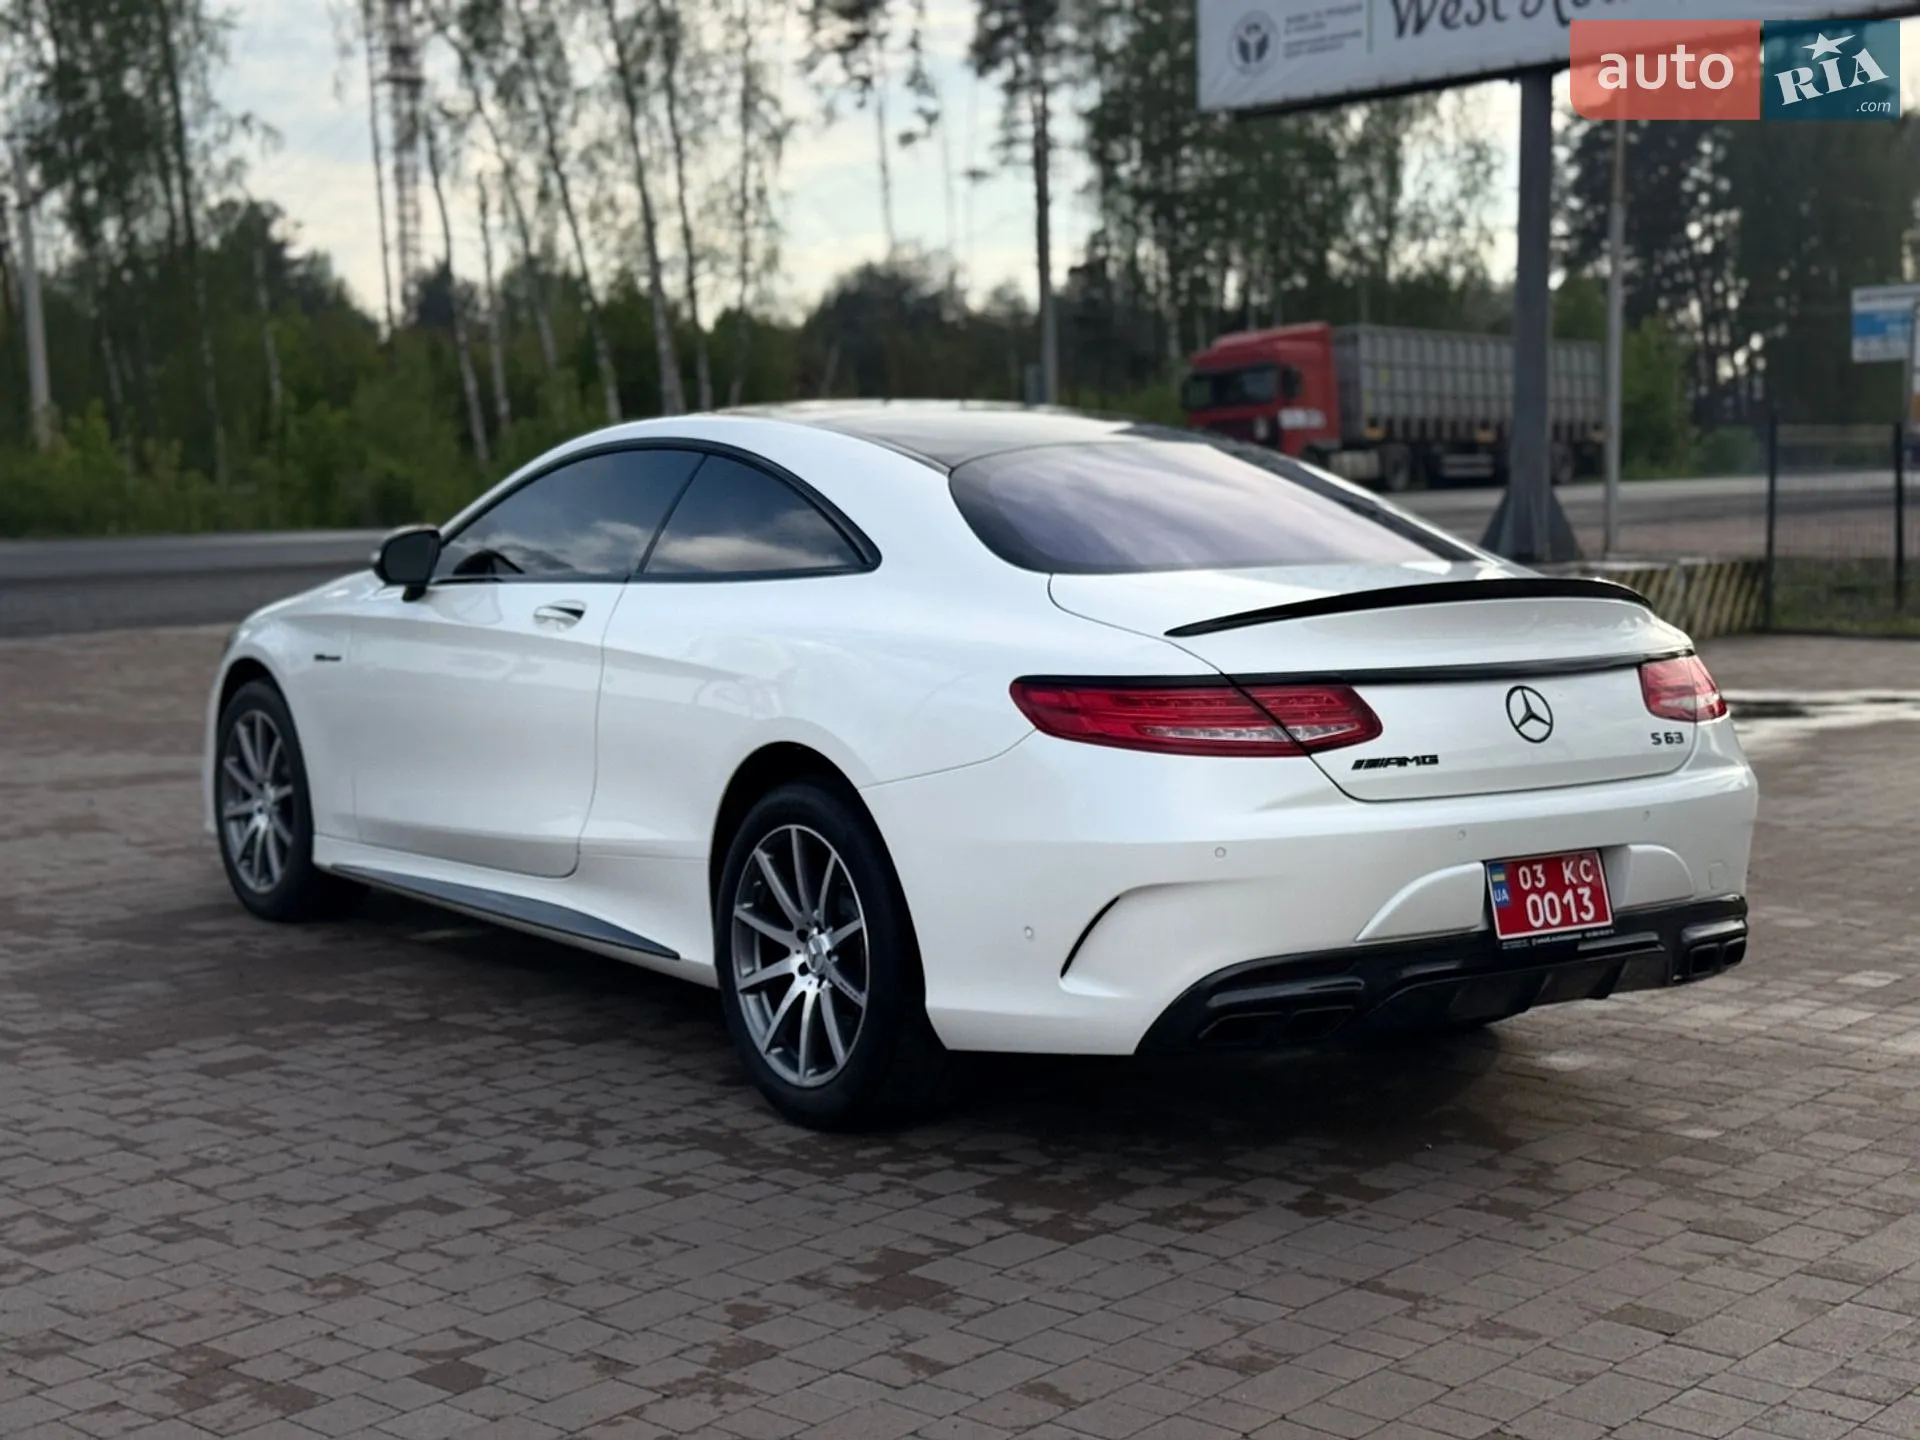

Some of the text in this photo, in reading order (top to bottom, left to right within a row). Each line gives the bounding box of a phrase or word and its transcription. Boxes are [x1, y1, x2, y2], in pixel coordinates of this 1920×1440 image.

[1651, 731, 1684, 745] S 63
[1518, 859, 1594, 890] 03 KC
[1494, 887, 1509, 902] UA
[1526, 886, 1595, 928] 0013
